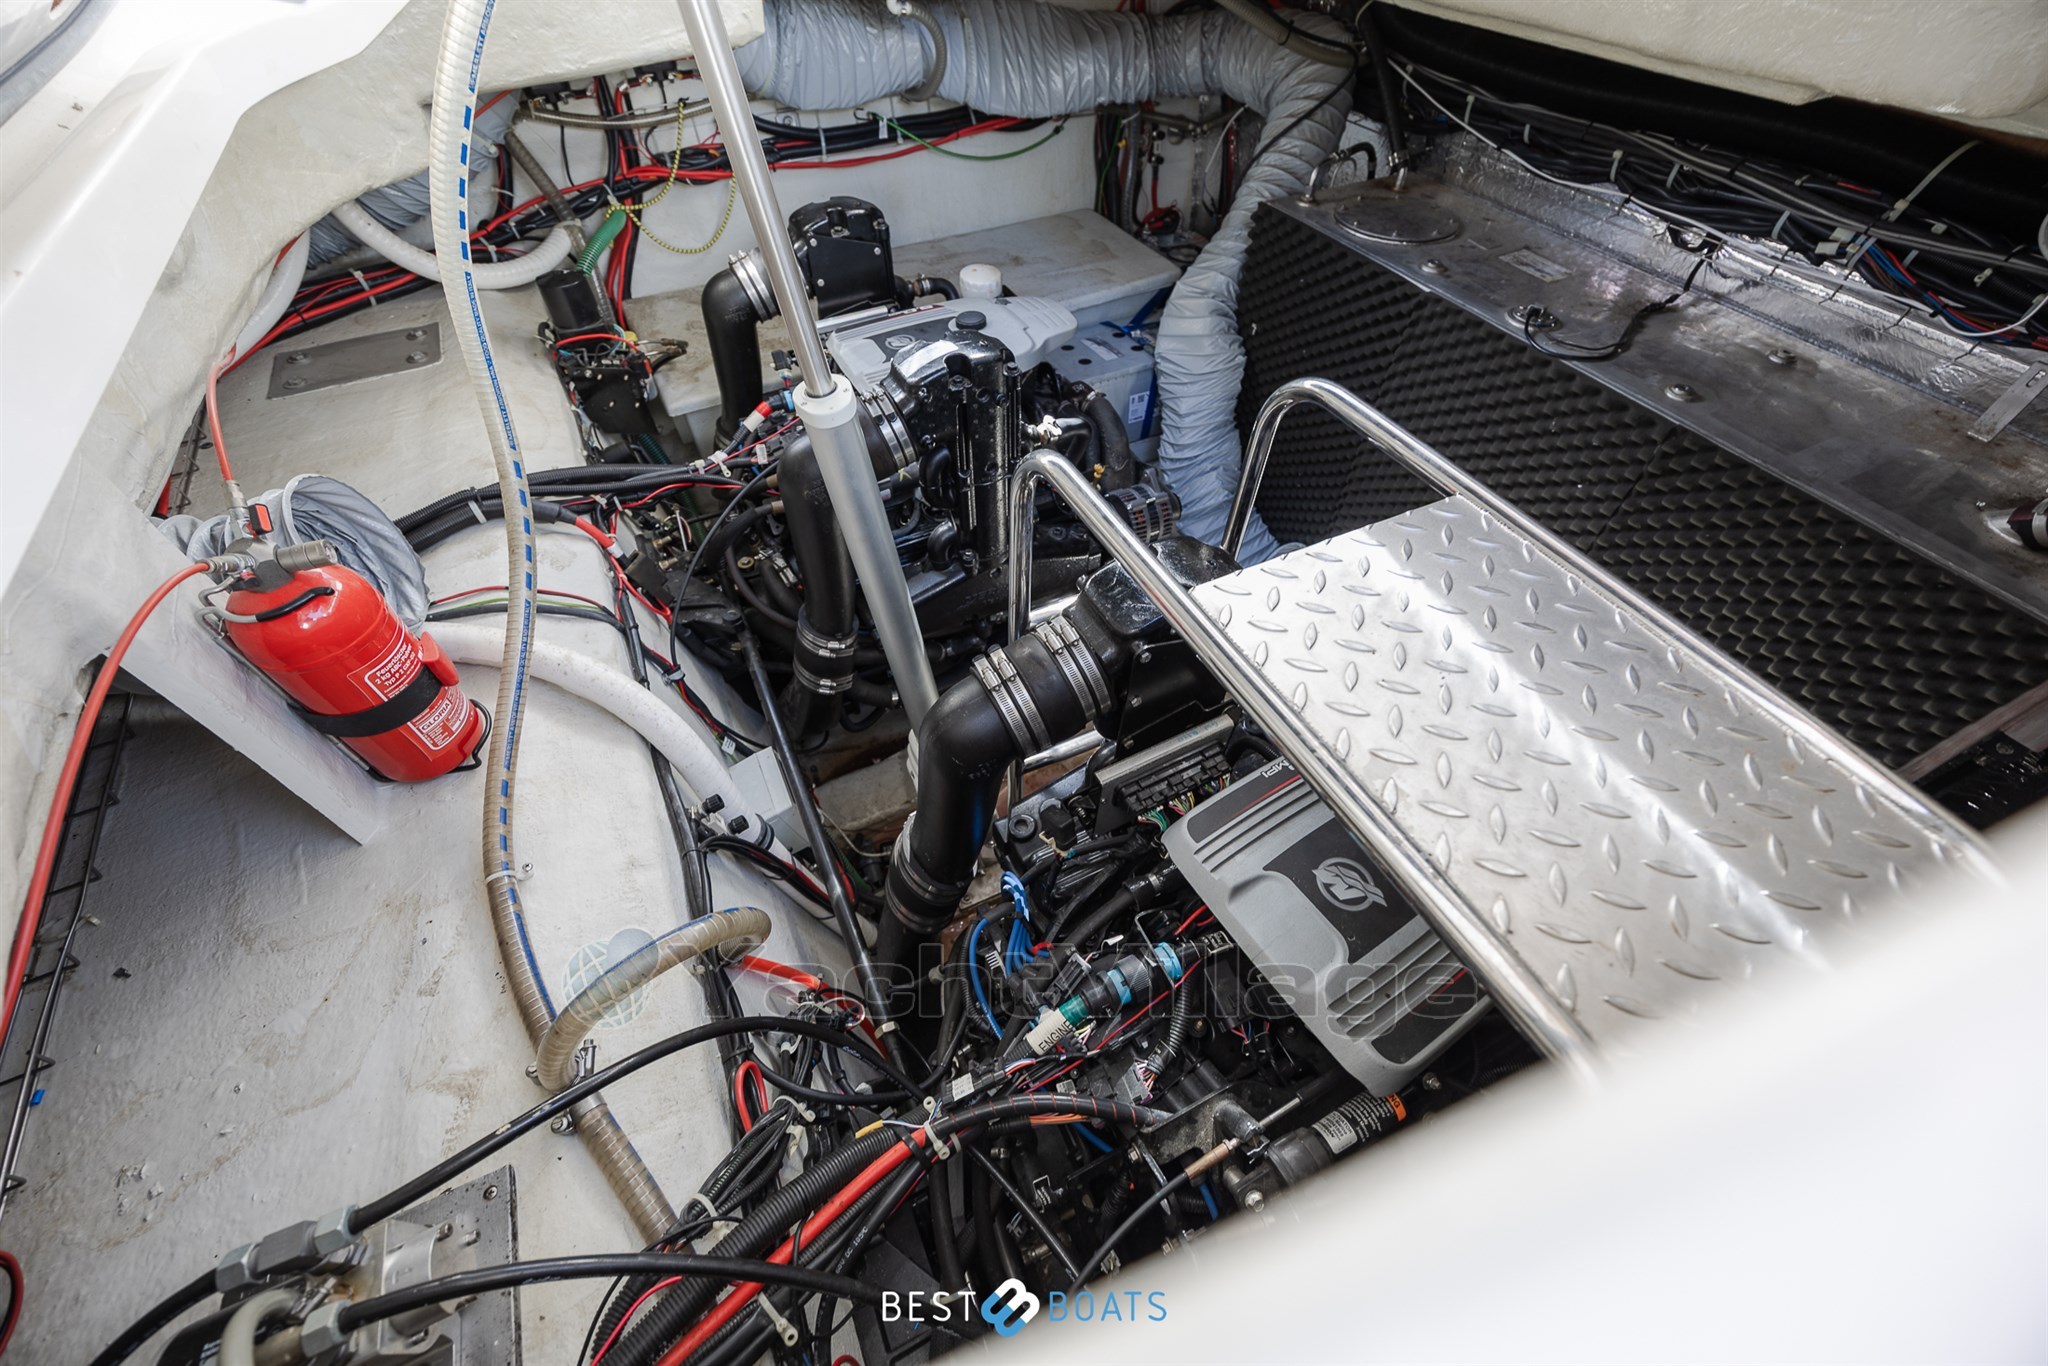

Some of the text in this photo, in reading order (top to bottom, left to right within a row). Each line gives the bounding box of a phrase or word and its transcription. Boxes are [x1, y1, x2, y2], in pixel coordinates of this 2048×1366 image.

[465, 274, 473, 291] ITALY
[470, 299, 479, 316] MADE
[475, 316, 485, 342] QUALITY
[376, 642, 407, 677] Feuerlöscher
[381, 671, 391, 682] kg
[384, 677, 396, 687] Typ
[421, 702, 450, 731] GLORIA
[1038, 1021, 1074, 1052] ENGINE
